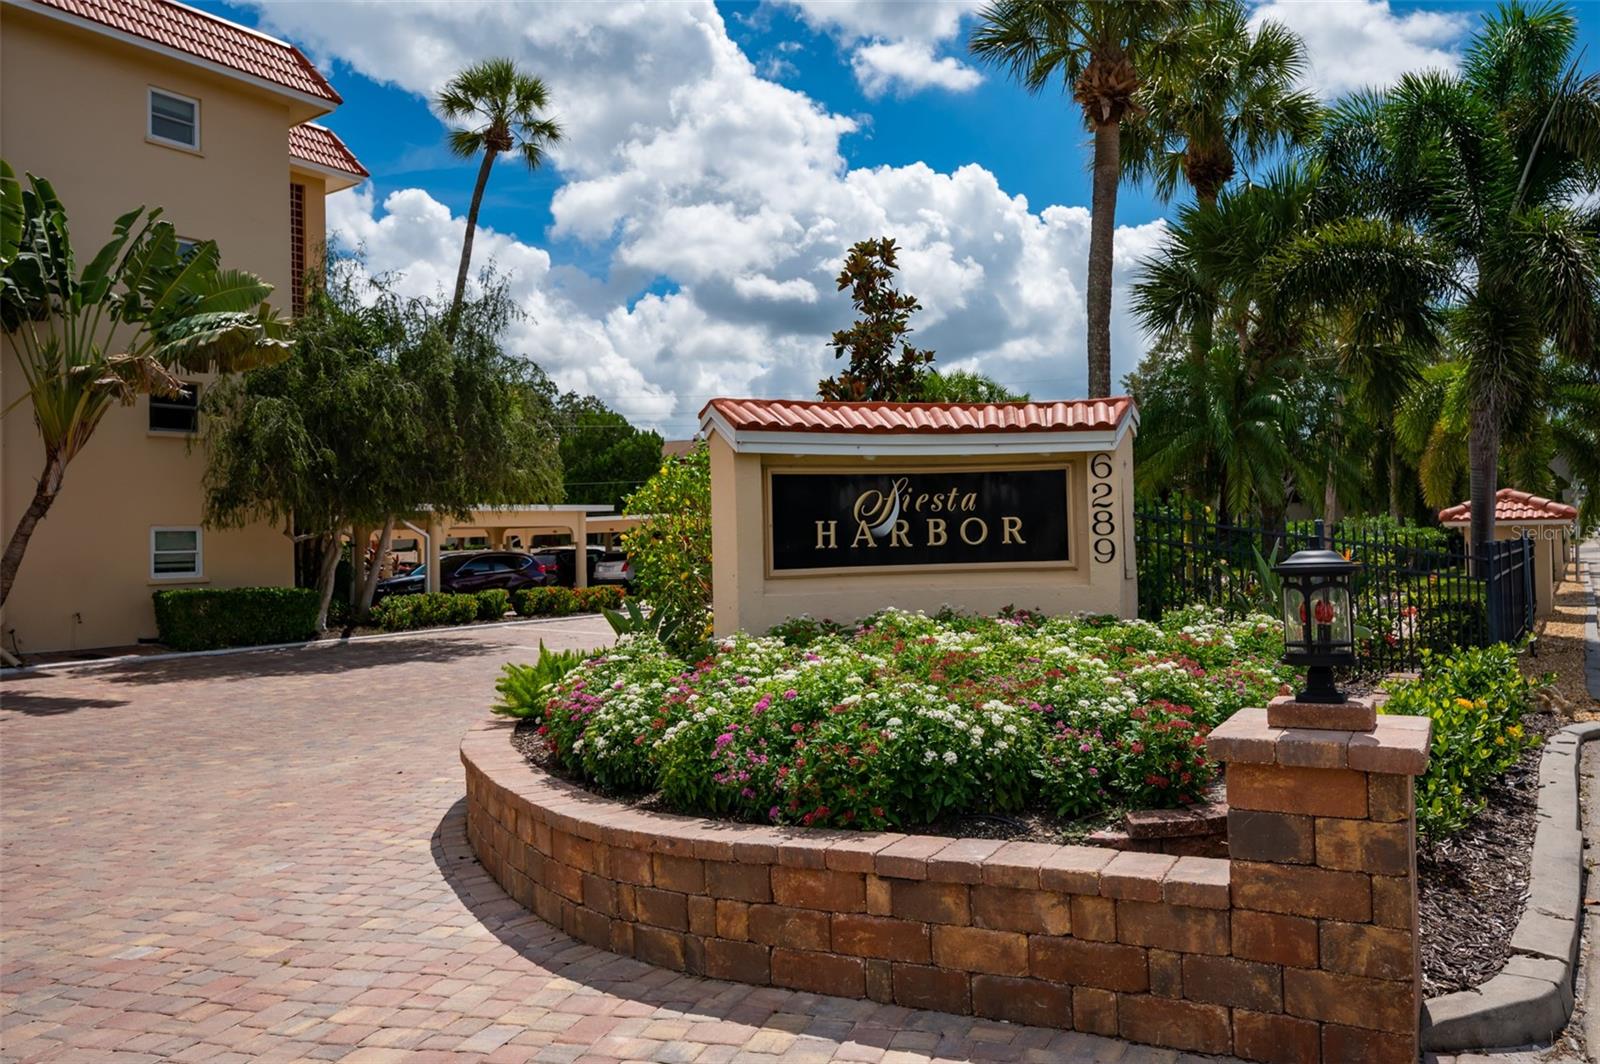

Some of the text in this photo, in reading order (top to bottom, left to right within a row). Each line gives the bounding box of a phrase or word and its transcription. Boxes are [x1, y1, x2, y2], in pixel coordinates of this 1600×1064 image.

[853, 477, 977, 528] Siesta
[1090, 452, 1116, 564] 6289
[815, 516, 1027, 549] HARBOR
